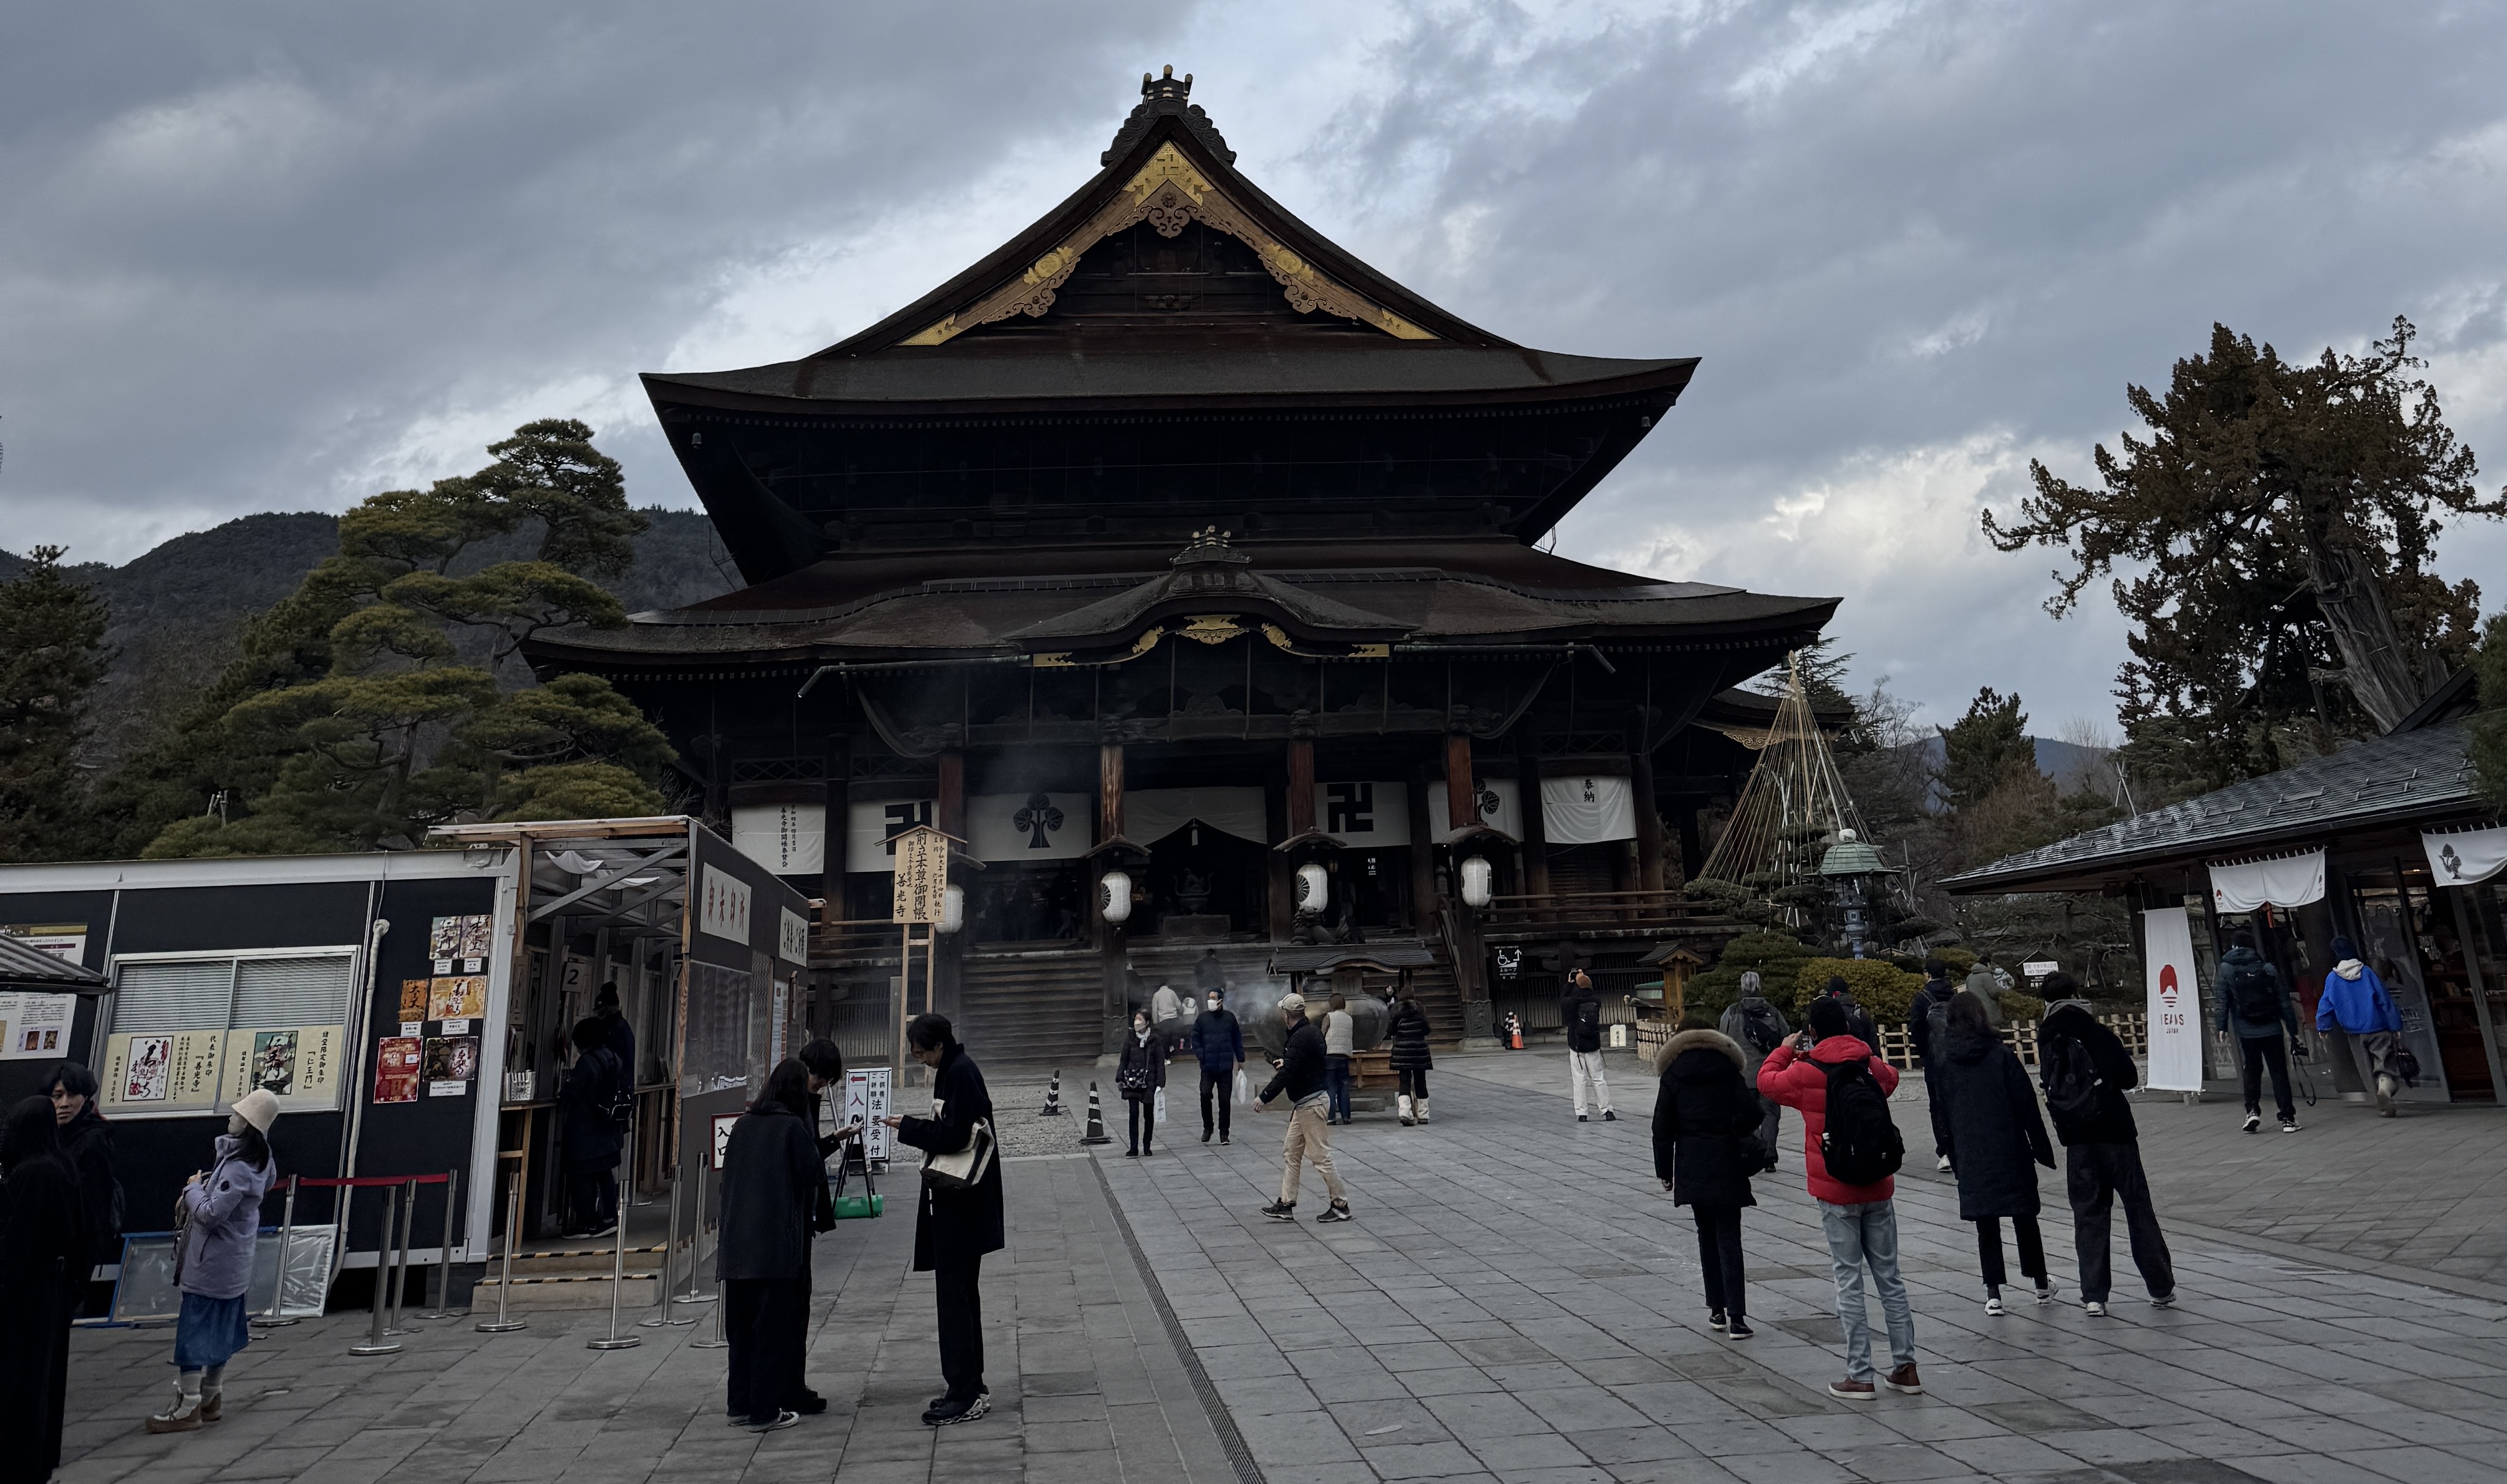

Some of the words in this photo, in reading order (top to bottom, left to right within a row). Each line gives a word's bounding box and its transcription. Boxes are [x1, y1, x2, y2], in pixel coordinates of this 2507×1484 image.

[1584, 778, 1594, 802] 奉納
[895, 872, 907, 918] 善光寺
[913, 831, 928, 920] 前立本尊御開帳
[708, 875, 744, 936] 御朱印所
[567, 968, 579, 985] 2
[205, 1035, 217, 1077] 代表御朱印
[717, 1126, 730, 1156] 入口
[870, 1100, 882, 1156] 法要受付
